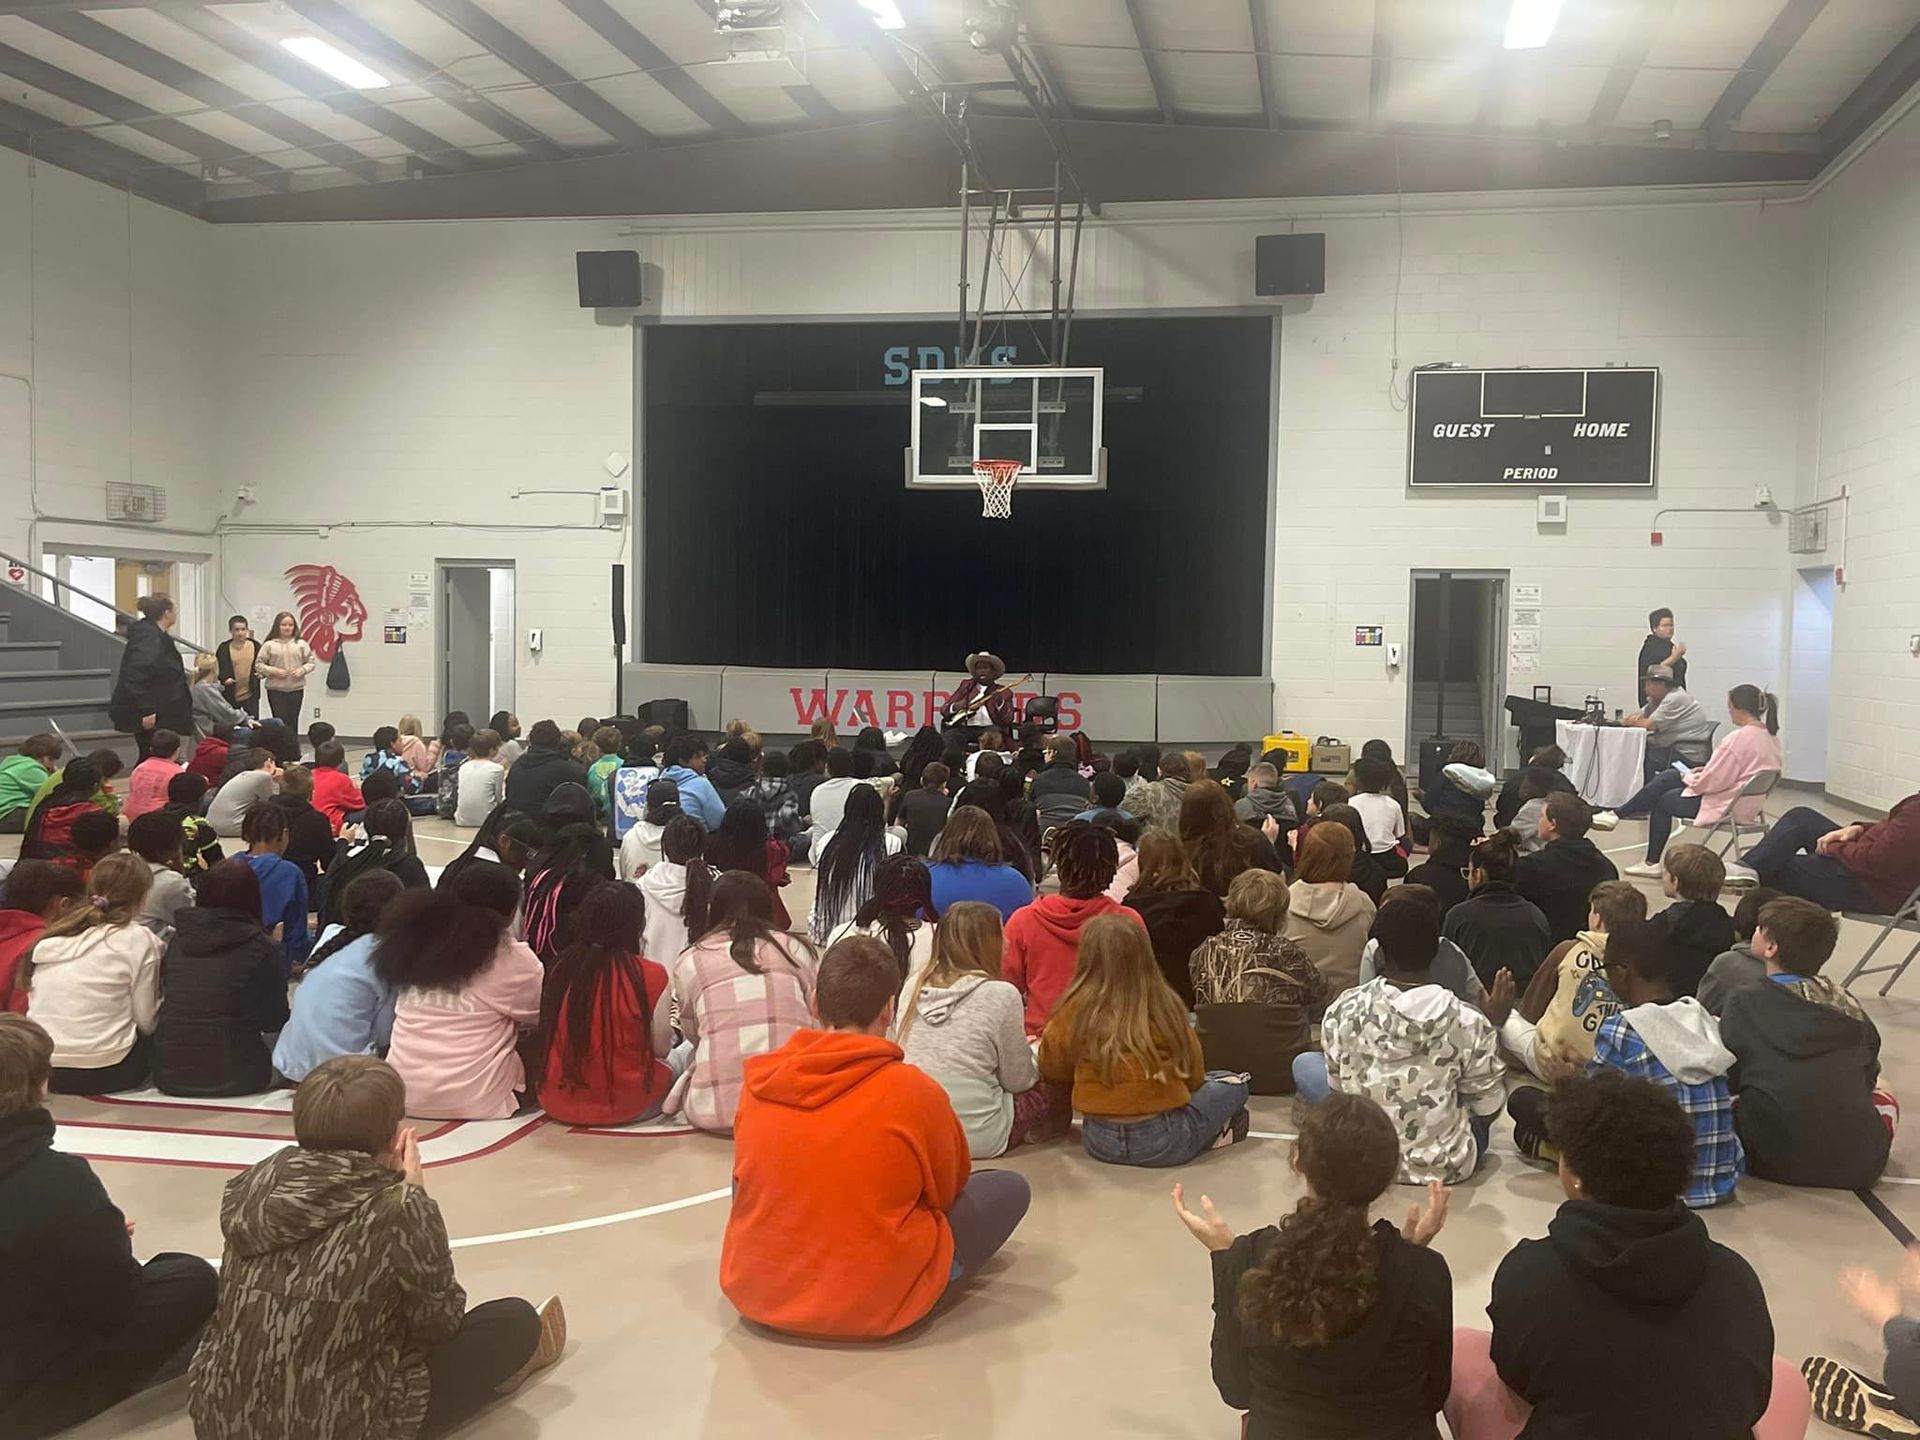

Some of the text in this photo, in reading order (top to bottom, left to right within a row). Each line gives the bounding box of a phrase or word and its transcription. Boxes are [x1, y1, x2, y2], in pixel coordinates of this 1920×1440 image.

[1432, 423, 1495, 438] GUEST
[1573, 422, 1630, 438] HOME
[1502, 467, 1559, 480] PERIOD
[789, 687, 1083, 731] WARRRS
